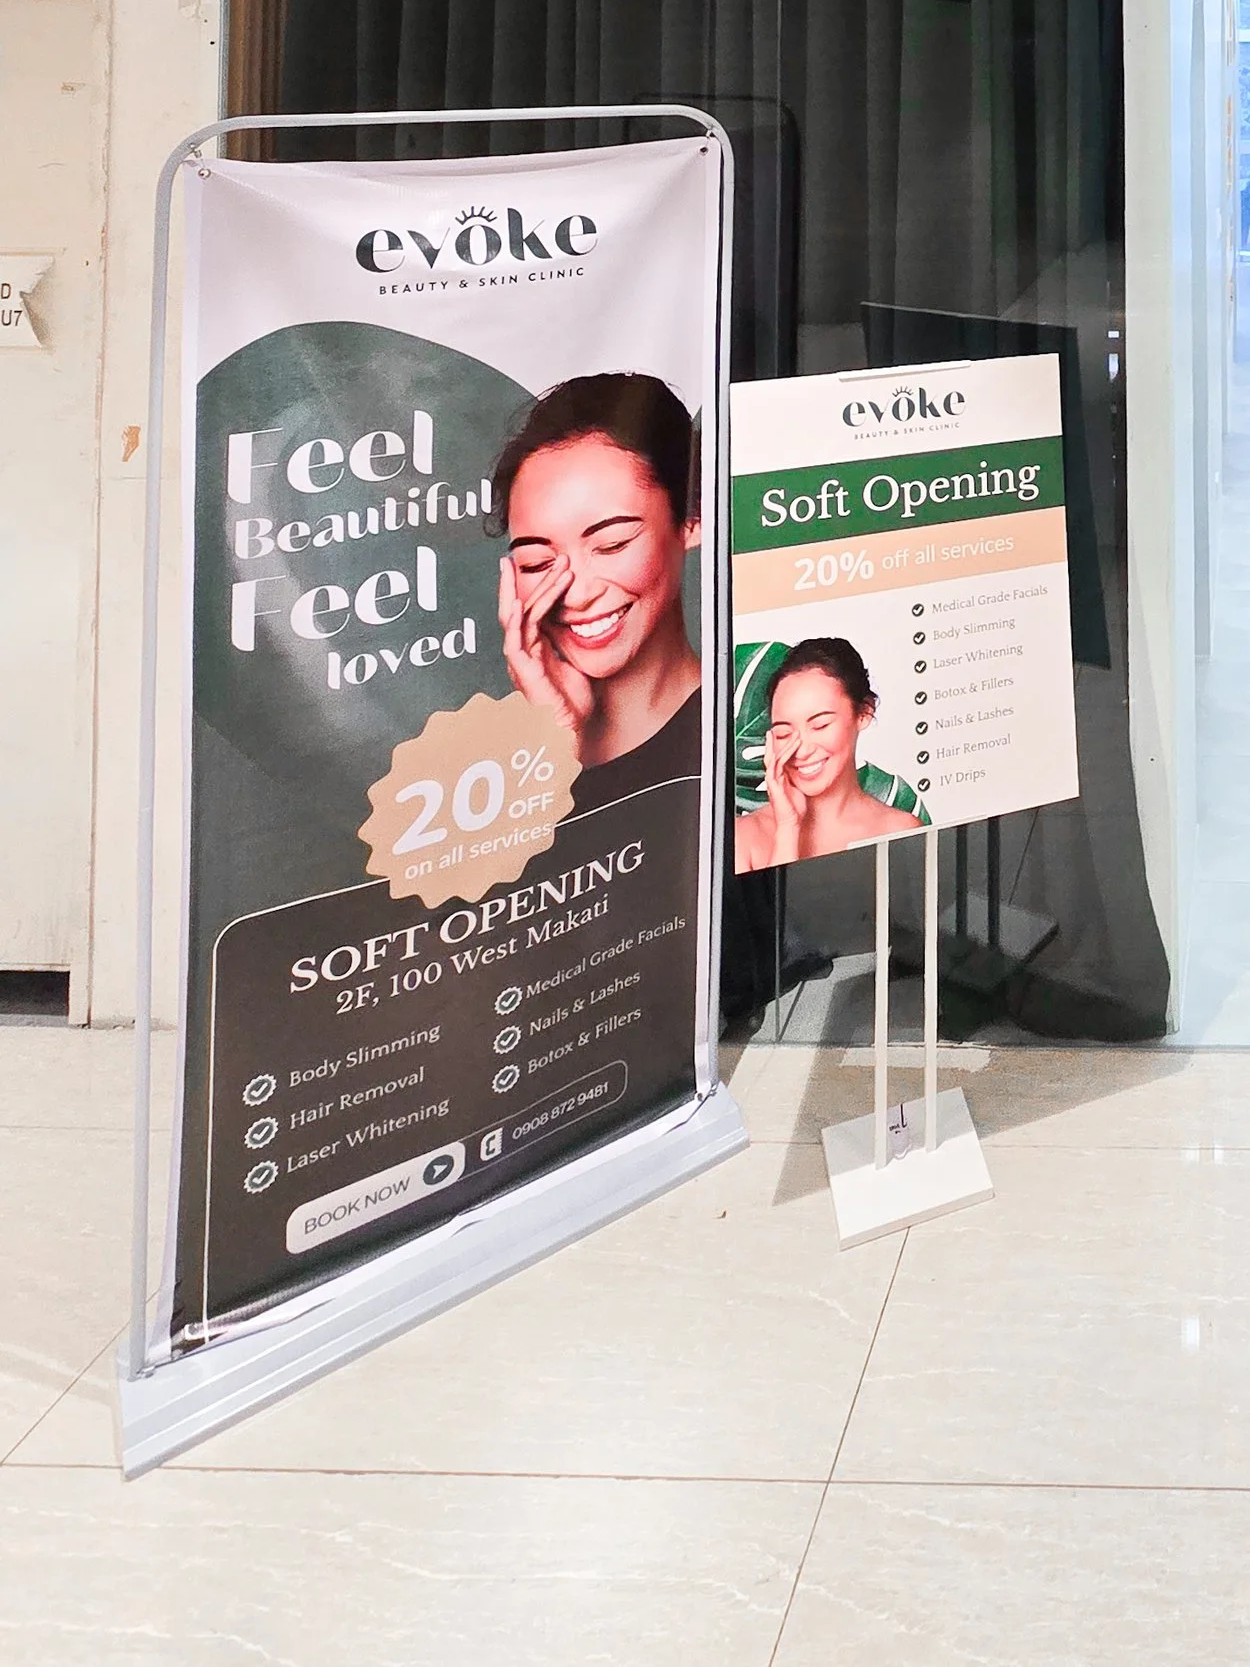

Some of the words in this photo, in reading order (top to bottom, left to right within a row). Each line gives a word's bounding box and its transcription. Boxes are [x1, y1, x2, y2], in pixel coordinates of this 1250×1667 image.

[355, 207, 599, 273] evoke
[379, 280, 449, 296] BEAUTY
[459, 279, 468, 289] &
[479, 275, 518, 287] SKIN
[528, 267, 585, 283] CLINIC
[842, 386, 966, 427] evoke
[854, 430, 889, 440] BEAUTY
[904, 426, 924, 435] SKIN
[929, 422, 960, 432] CLINIC
[227, 410, 433, 504] Feel
[234, 478, 492, 560] Beautiful
[761, 479, 850, 527] Soft
[862, 460, 1041, 519] Opening
[794, 549, 875, 591] 20%
[882, 547, 914, 570] off
[915, 543, 936, 565] all
[941, 536, 1015, 562] services
[231, 546, 437, 652] Feel
[932, 596, 975, 614] Medical
[978, 591, 1011, 606] Grade
[1013, 585, 1048, 600] Facials
[327, 618, 476, 690] loved
[933, 626, 961, 641] Body
[964, 618, 1016, 636] Slimming
[933, 655, 962, 669] Laser
[965, 645, 1023, 663] Whitening
[934, 687, 966, 700] Botox
[969, 682, 978, 693] &
[981, 677, 1014, 691] Fillers
[935, 715, 963, 730] Nails
[965, 713, 975, 723] &
[978, 706, 1014, 721] Lashes
[936, 745, 960, 759] Hair
[963, 733, 1011, 754] Removal
[508, 791, 555, 819] OFF
[940, 774, 953, 787] IV
[956, 768, 986, 782] Drips
[405, 859, 432, 880] on
[439, 844, 463, 869] all
[469, 821, 552, 859] services
[290, 922, 429, 993] SOFT
[439, 840, 645, 945] OPENING
[335, 982, 379, 1015] 2F,
[390, 961, 442, 998] 100
[450, 937, 518, 975] West
[526, 894, 610, 949] Makati
[525, 958, 586, 999] Medical
[589, 938, 634, 967] Grade
[638, 916, 686, 945] Facials
[529, 1007, 569, 1035] Nails
[572, 998, 585, 1014] &
[589, 971, 641, 1005] Lashes
[289, 1059, 341, 1087] Body
[346, 1025, 440, 1068] Slimming
[527, 1042, 574, 1074] Botox
[577, 1032, 591, 1047] &
[595, 1007, 642, 1039] Fillers
[290, 1102, 334, 1130] Hair
[340, 1066, 424, 1110] Removal
[512, 1112, 549, 1139] 0908
[551, 1098, 575, 1119] 872
[577, 1081, 609, 1105] 9481
[287, 1140, 340, 1173] Laser
[346, 1098, 450, 1147] Whitening
[304, 1198, 362, 1235] BOOK
[364, 1176, 412, 1213] NOW
